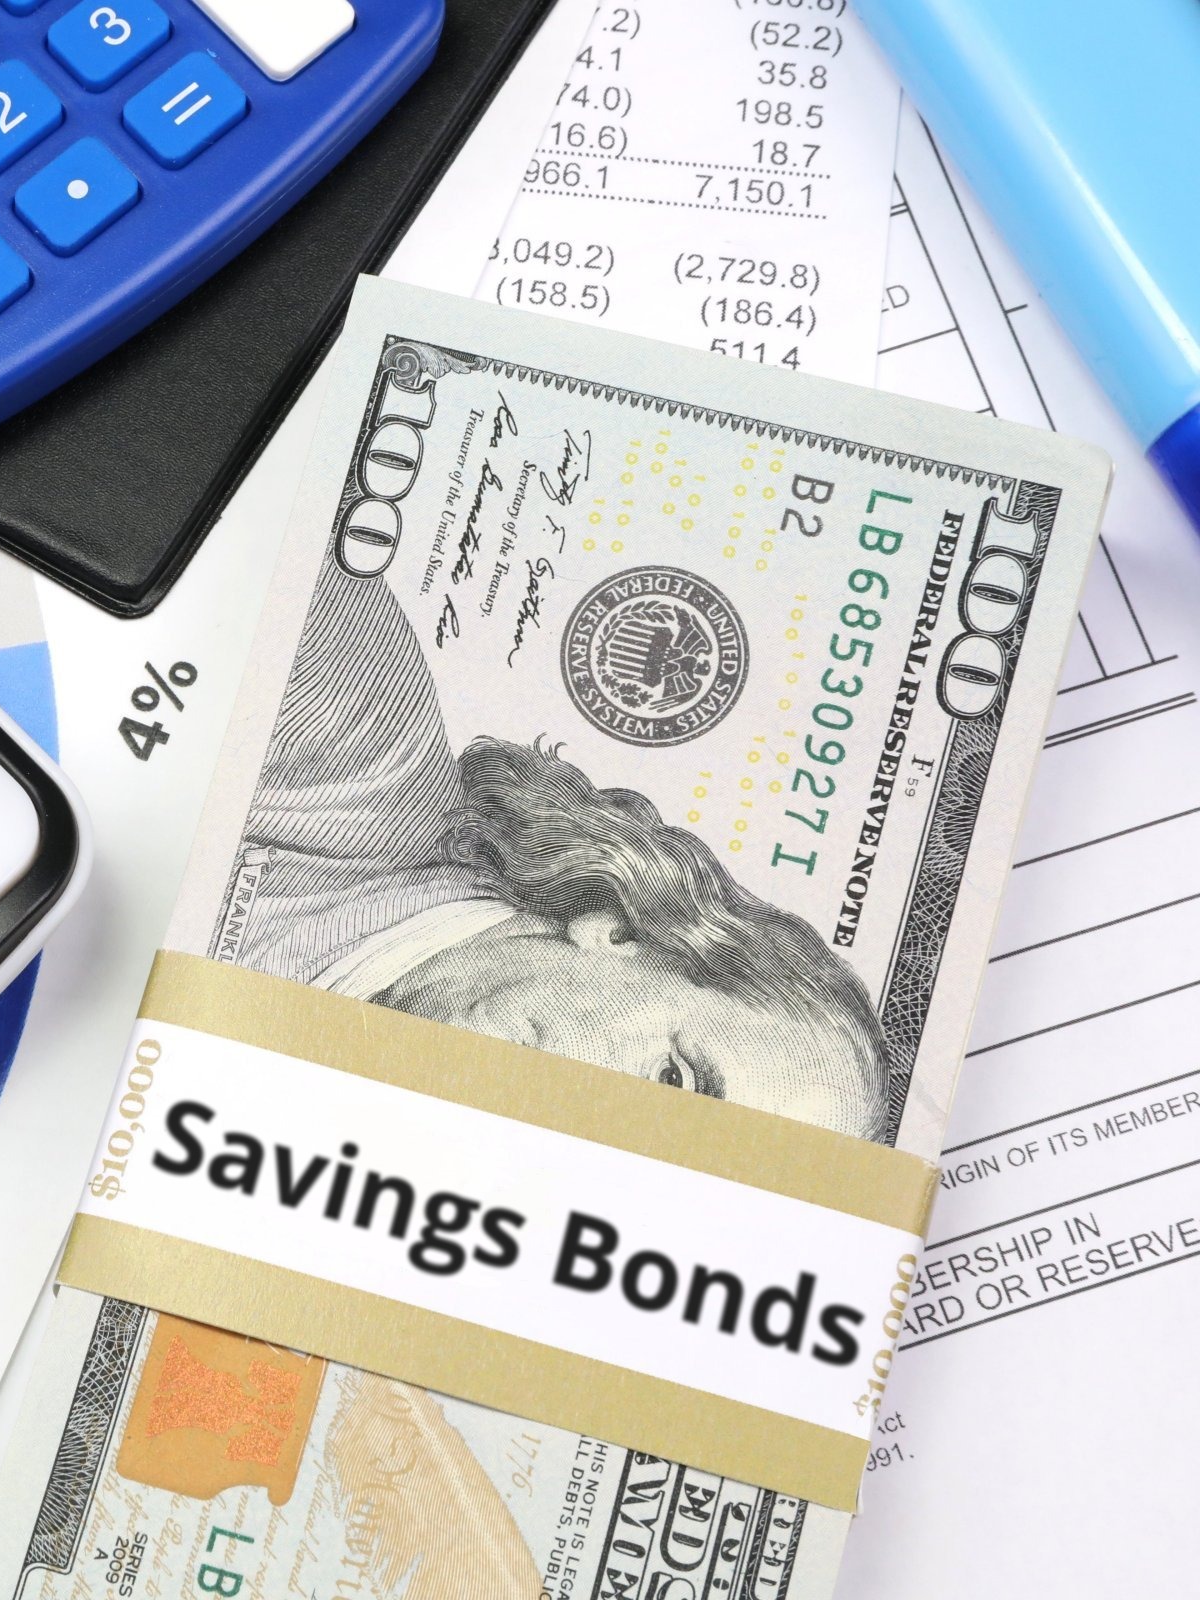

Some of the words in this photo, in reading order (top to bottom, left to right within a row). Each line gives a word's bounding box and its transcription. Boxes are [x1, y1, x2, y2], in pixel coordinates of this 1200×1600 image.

[90, 8, 130, 44] 3
[750, 20, 843, 58] (52.2)
[757, 60, 827, 90] 35.8
[736, 98, 824, 129] 198.5
[753, 139, 821, 168] 18.7
[695, 174, 812, 208] 7,150.1
[674, 252, 820, 296] (2,729.8)
[496, 276, 611, 318] (158.5)
[700, 296, 817, 337] (186.4)
[457, 409, 485, 469] Treasurer
[446, 487, 461, 507] the
[449, 471, 464, 488] of
[507, 460, 538, 520] Secretary
[502, 522, 518, 539] of
[779, 474, 835, 537] B2
[432, 511, 457, 556] United
[499, 537, 515, 557] the
[420, 555, 443, 596] States.
[480, 561, 510, 618] Treasury.
[605, 575, 695, 602] FEDERAL
[904, 509, 965, 675] FEDERAL
[570, 600, 609, 683] RESERVE
[706, 602, 739, 676] UNITED
[118, 661, 198, 761] 4%
[581, 687, 654, 737] SYSTEM
[676, 678, 732, 733] STATES
[784, 568, 889, 834] 68530927
[859, 677, 921, 847] RESERVE
[833, 848, 877, 948] NOTE
[88, 1039, 162, 1201] $10,000
[1007, 1141, 1040, 1167] OF
[1047, 1128, 1089, 1155] ITS
[1093, 1091, 1200, 1141] MEMBER
[150, 1098, 528, 1278] Savings
[550, 1208, 866, 1368] Bonds
[1064, 1212, 1102, 1245] IN
[976, 1274, 1032, 1310] OR
[556, 1467, 585, 1529] DEBTS,
[576, 1479, 600, 1529] NOTE
[93, 1547, 109, 1561] A
[105, 1535, 130, 1586] 2009
[119, 1531, 149, 1599] SERIES
[197, 1525, 255, 1598] LB
[571, 1533, 587, 1551] IS
